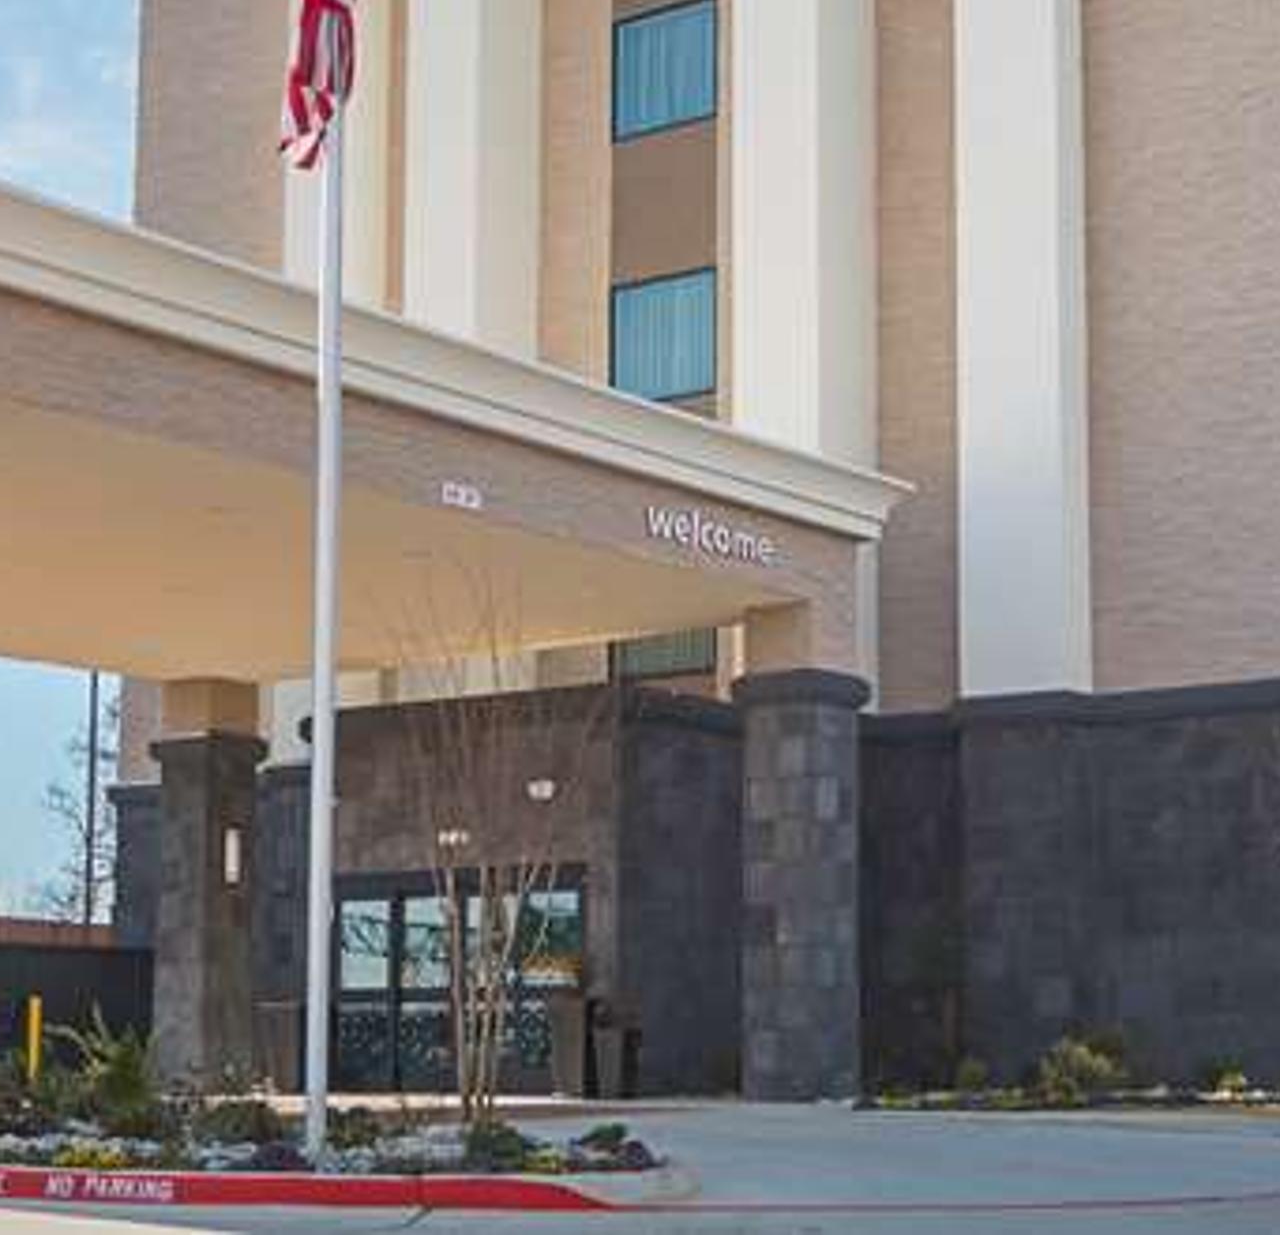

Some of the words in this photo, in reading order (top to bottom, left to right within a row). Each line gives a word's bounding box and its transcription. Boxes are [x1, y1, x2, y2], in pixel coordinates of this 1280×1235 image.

[647, 506, 777, 563] welcome
[44, 1173, 73, 1197] NO
[81, 1175, 175, 1201] PARKING
